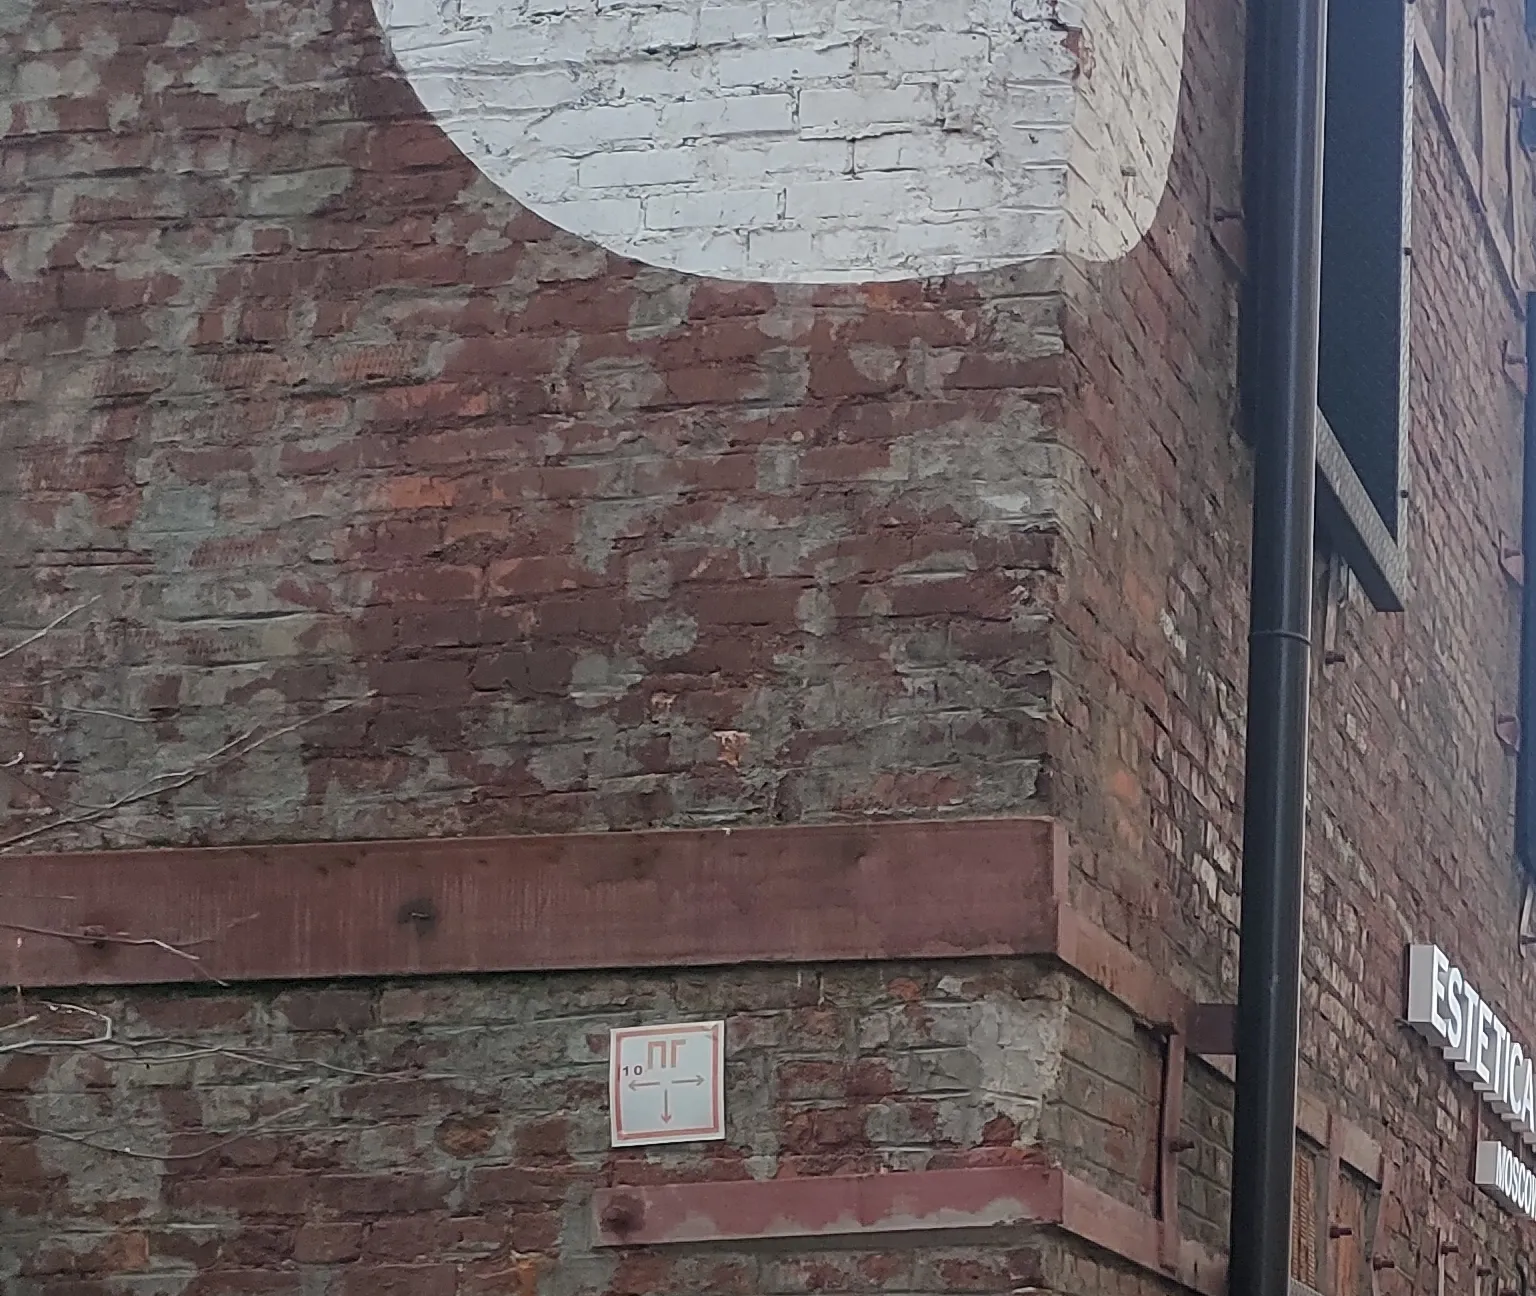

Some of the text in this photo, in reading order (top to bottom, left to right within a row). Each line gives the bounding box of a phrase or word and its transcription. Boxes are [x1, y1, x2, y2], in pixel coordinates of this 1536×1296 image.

[647, 1038, 687, 1070] ПГ
[1430, 944, 1536, 1132] ESTETICA
[622, 1065, 643, 1077] 10
